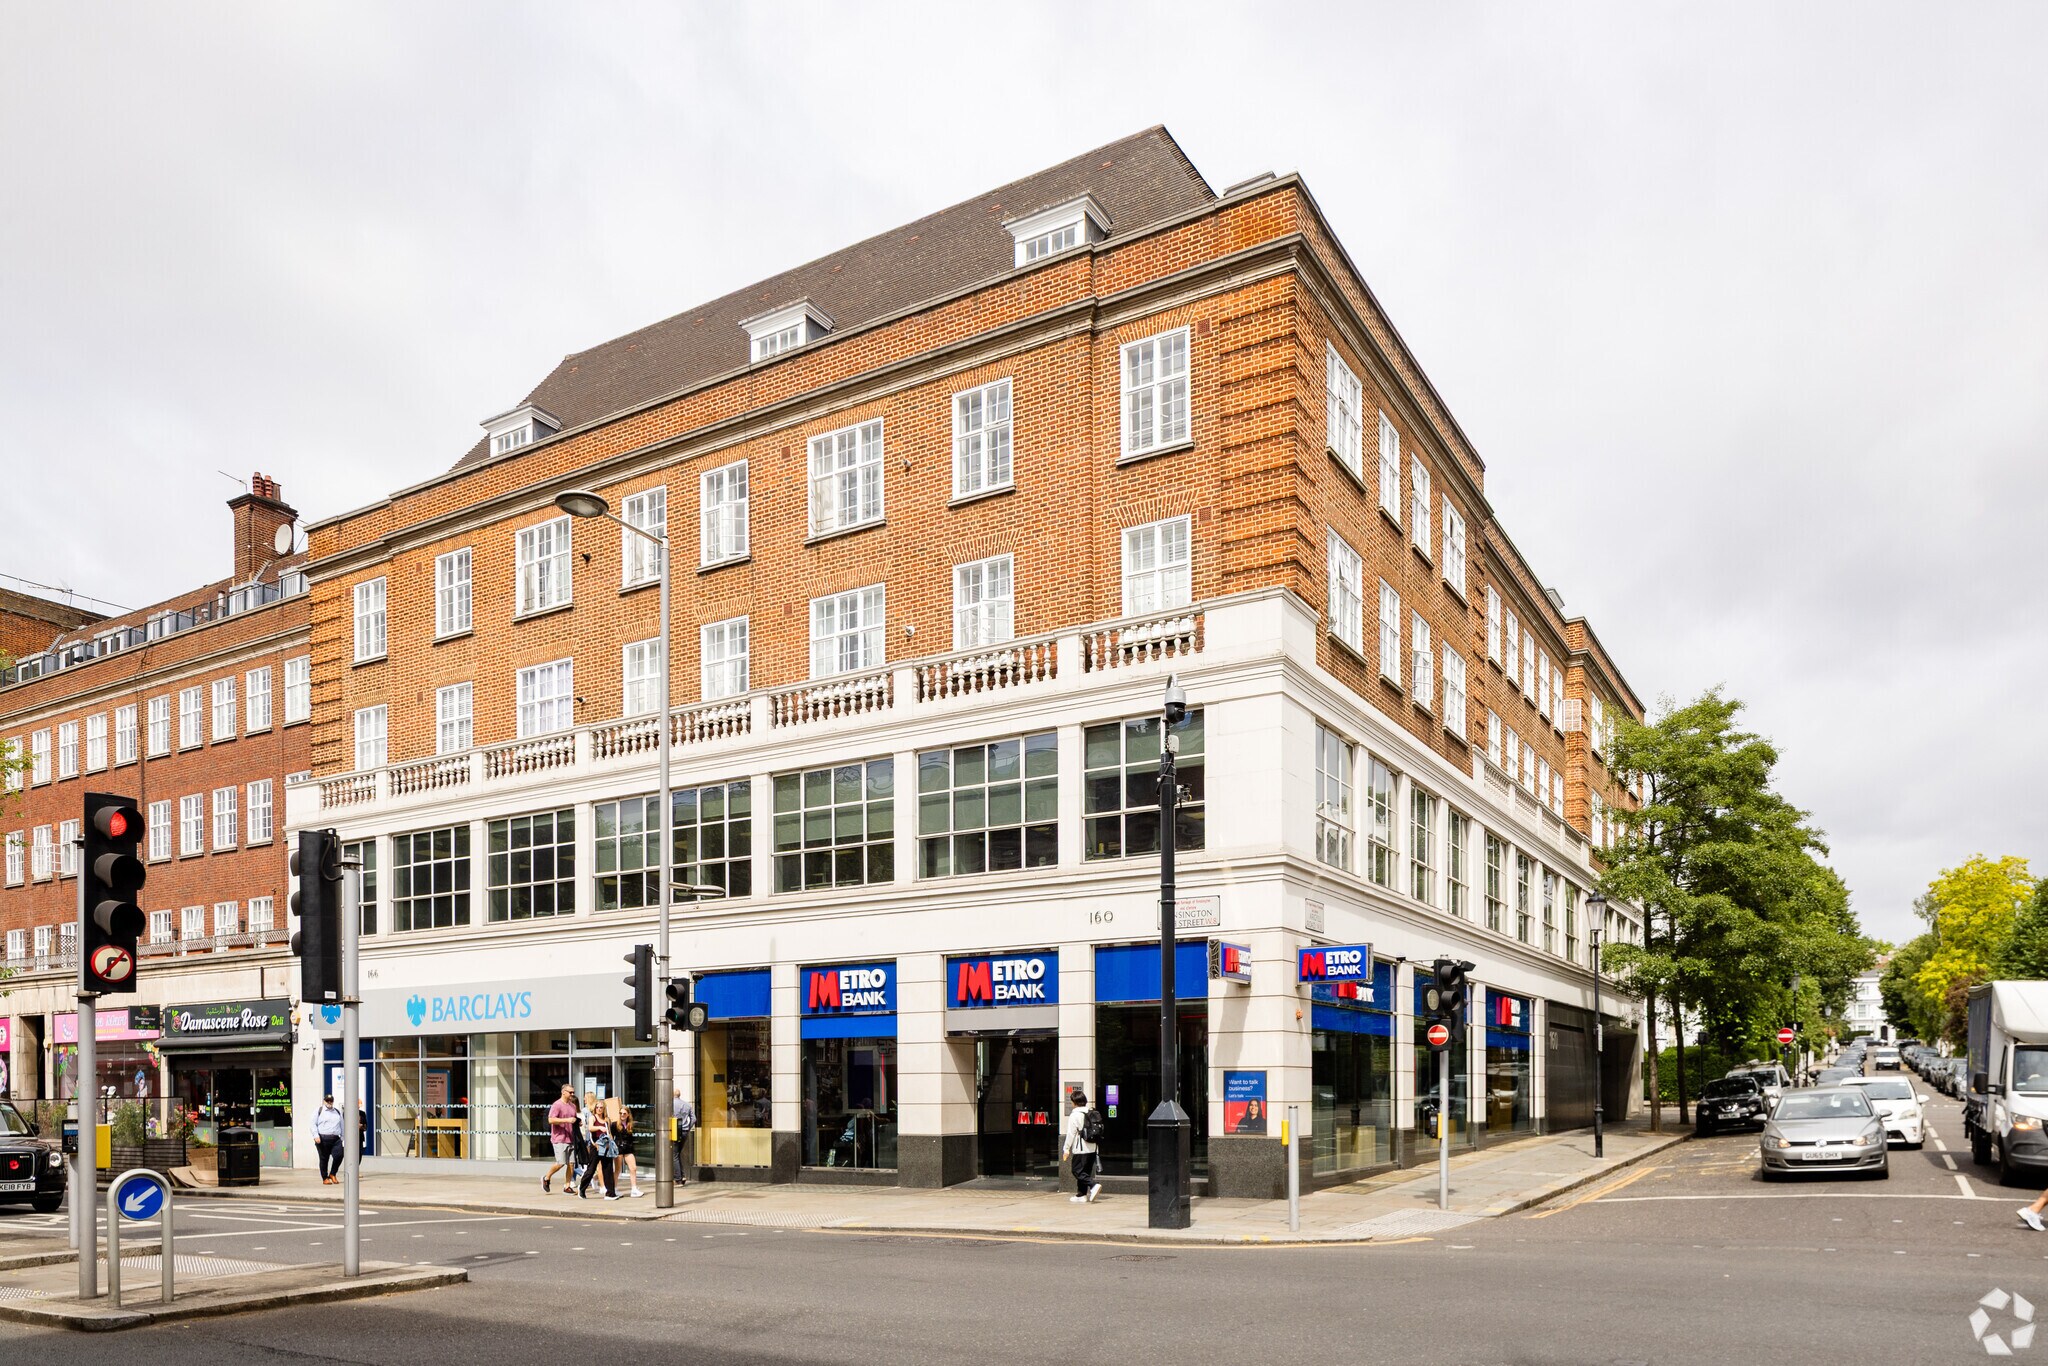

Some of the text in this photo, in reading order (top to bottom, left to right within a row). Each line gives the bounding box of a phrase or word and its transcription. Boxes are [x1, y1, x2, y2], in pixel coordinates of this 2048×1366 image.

[1090, 910, 1114, 925] 160
[1301, 950, 1362, 977] METRO
[1327, 964, 1362, 976] BANK
[808, 968, 887, 1008] METRO
[957, 958, 1046, 1001] METRO
[994, 983, 1046, 1000] BANK
[431, 991, 532, 1022] BARCLAYS
[842, 991, 887, 1007] BANK
[180, 1007, 284, 1031] Damascene Rose Deli
